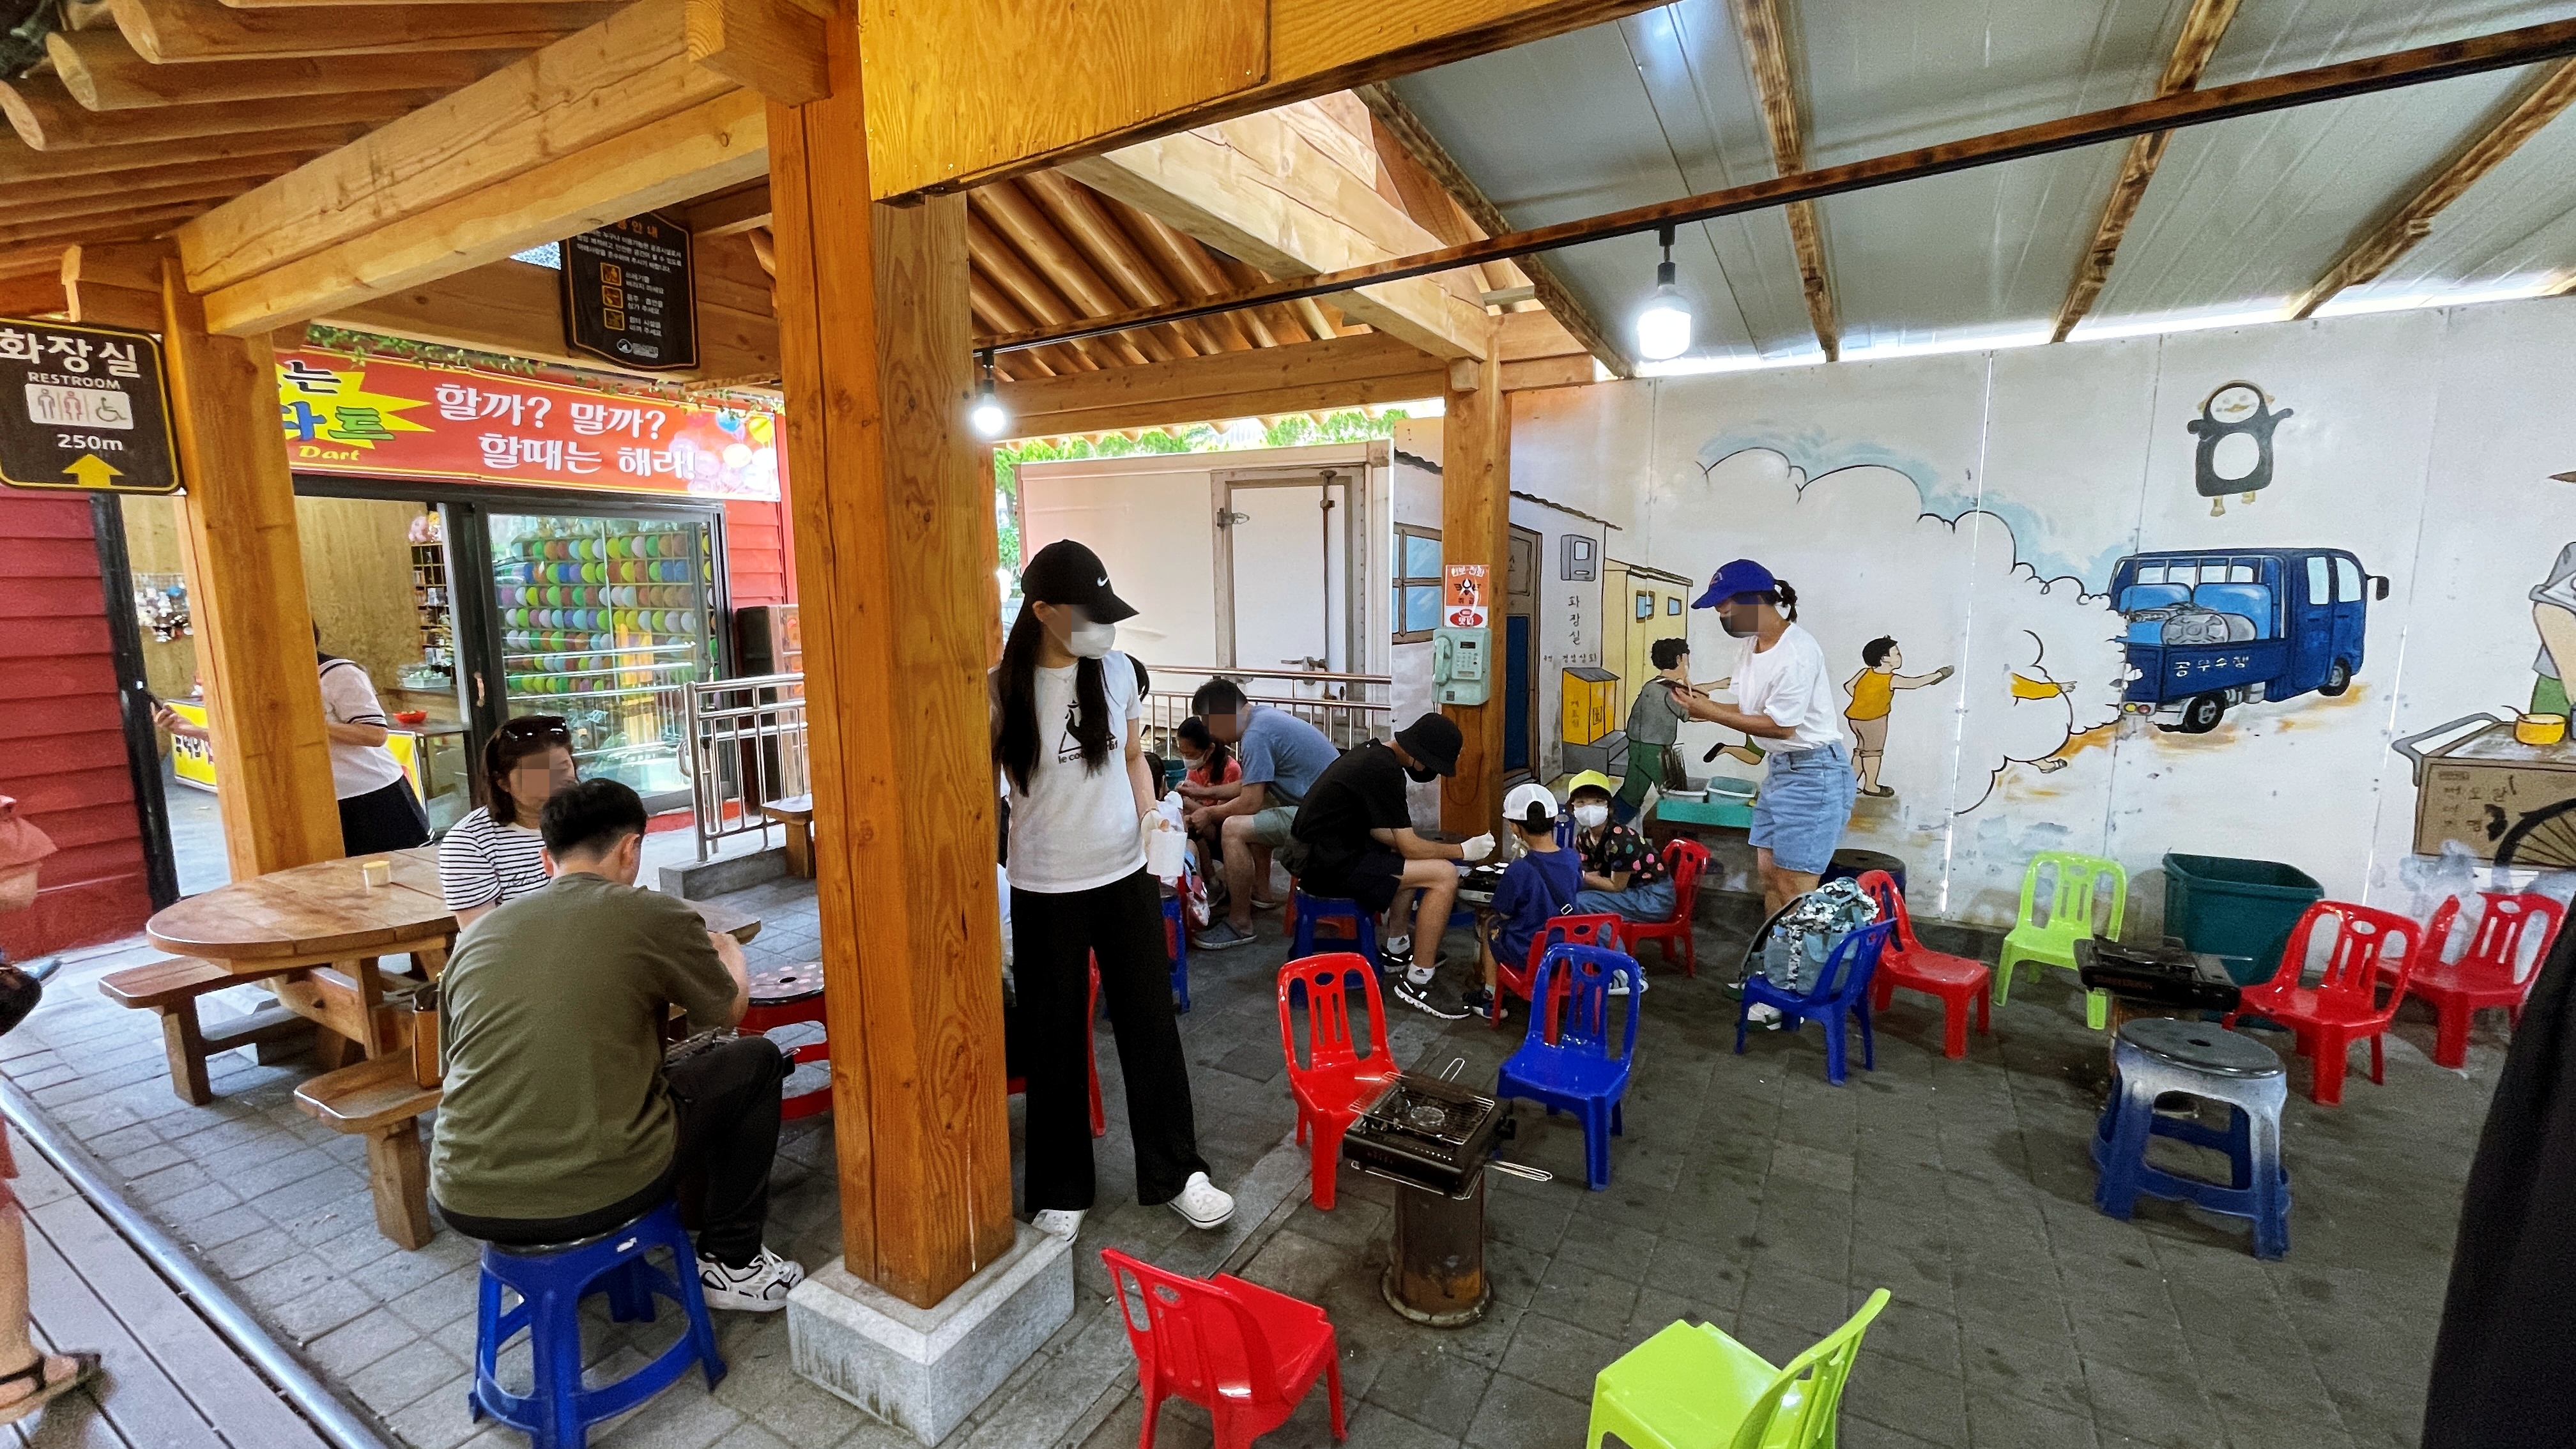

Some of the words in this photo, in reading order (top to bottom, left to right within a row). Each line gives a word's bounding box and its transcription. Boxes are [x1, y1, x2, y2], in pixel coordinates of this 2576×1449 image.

[0, 328, 141, 378] 화장실
[27, 371, 121, 390] RESTROOM
[434, 383, 552, 429] 할까?
[570, 402, 666, 440] 말까?
[57, 433, 123, 451] 250m
[299, 445, 360, 461] Dart
[478, 433, 603, 474] 할때는
[617, 447, 696, 480] 해라!
